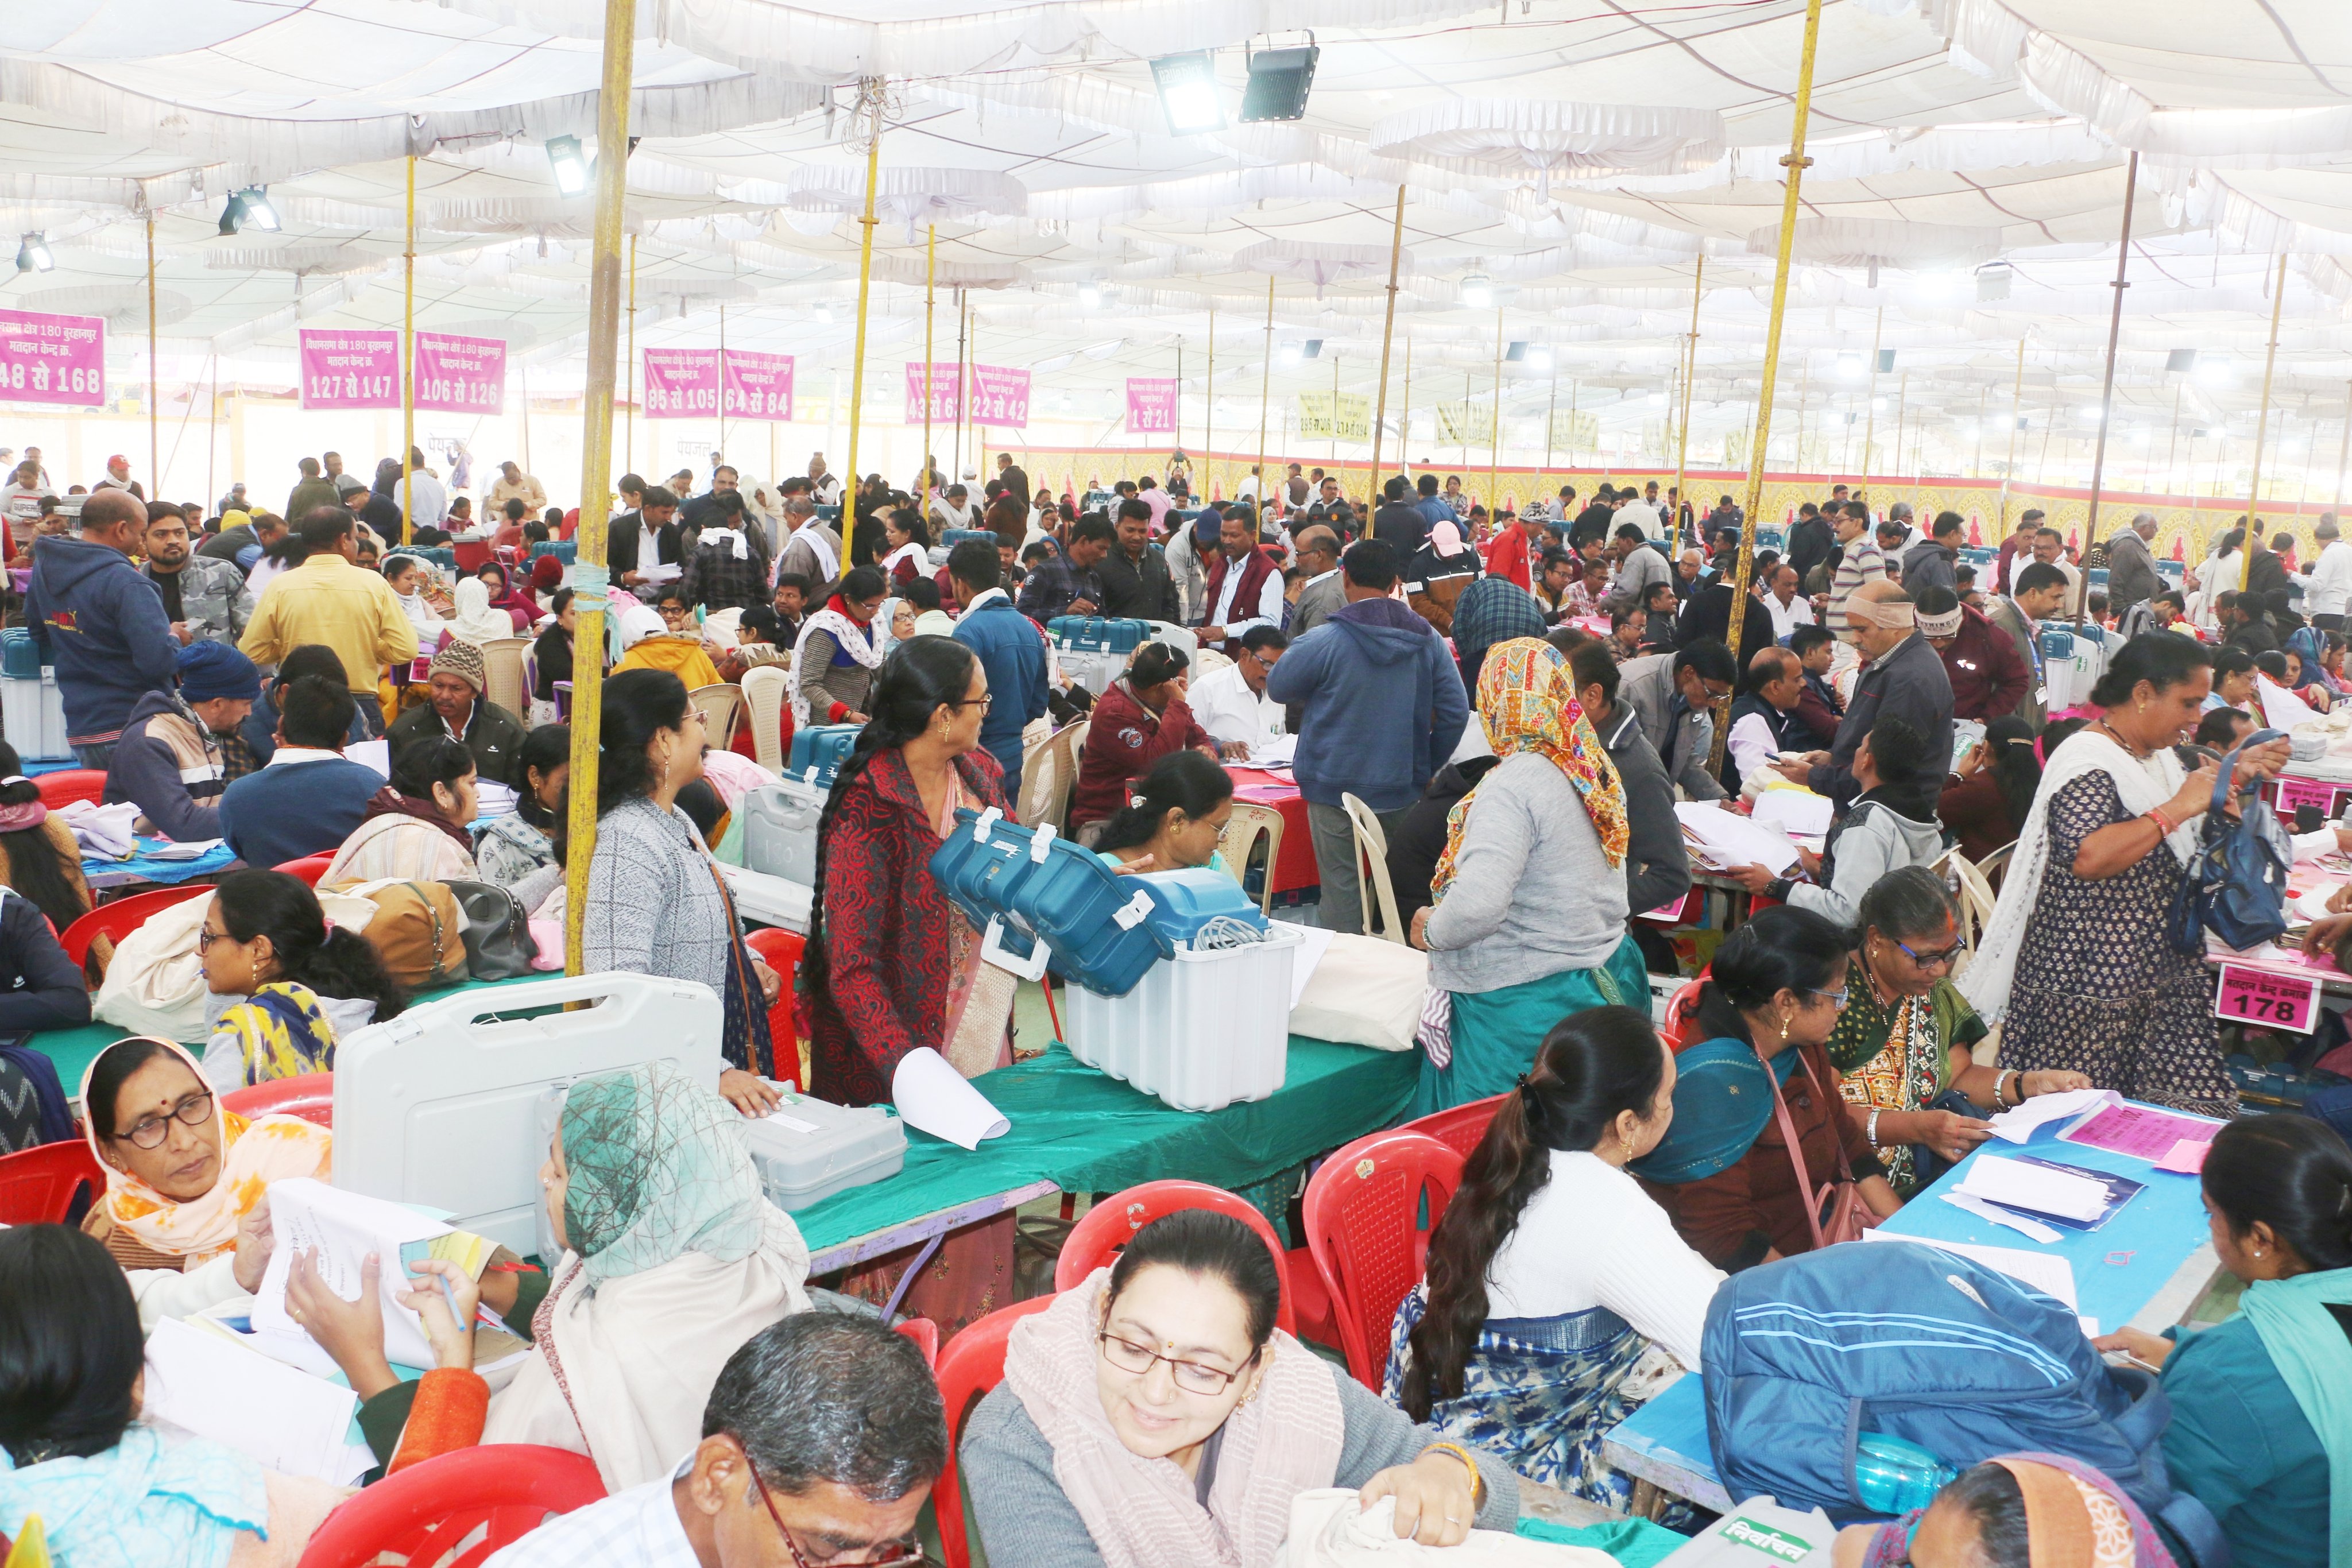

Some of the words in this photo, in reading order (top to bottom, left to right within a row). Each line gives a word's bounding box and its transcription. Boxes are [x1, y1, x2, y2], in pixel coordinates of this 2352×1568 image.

[24, 322, 38, 335] क्षेत्र
[41, 326, 61, 337] 180
[64, 327, 96, 343] बुरहानपुर
[10, 340, 38, 354] मतदान
[41, 341, 57, 357] केन्द्र
[306, 338, 336, 350] विधानसभा
[350, 340, 366, 350] 180
[367, 340, 393, 354] बुरहानपुर
[421, 338, 448, 352] विधानसभा
[462, 345, 476, 355] 180
[478, 347, 501, 360] बुरहानपुर
[327, 356, 348, 367] मतदान
[351, 355, 364, 368] केन्द्र
[439, 358, 459, 370] मतदान
[32, 360, 49, 390] से
[57, 366, 100, 394] 168
[311, 376, 341, 398] 127
[346, 371, 357, 398] से
[363, 376, 391, 398] 147
[423, 378, 450, 401] 106
[454, 377, 466, 403] से
[470, 383, 497, 405] 126
[648, 389, 667, 410] 85
[671, 385, 683, 409] से
[687, 389, 715, 409] 105
[725, 389, 745, 412] 64
[751, 386, 763, 413] से
[767, 392, 788, 415] 84
[908, 398, 926, 419] 43
[973, 396, 990, 417] 22
[994, 394, 1005, 419] से
[1008, 400, 1026, 421] 42
[1132, 409, 1139, 428] 1
[1143, 405, 1153, 428] से
[1155, 409, 1170, 428] 21
[1300, 417, 1312, 431] 295
[1356, 424, 1367, 438] 294
[677, 436, 711, 457] पेयजल
[2226, 979, 2256, 992] मतदान
[2234, 995, 2295, 1021] 178
[1724, 1520, 1809, 1561] निर्वाचन
